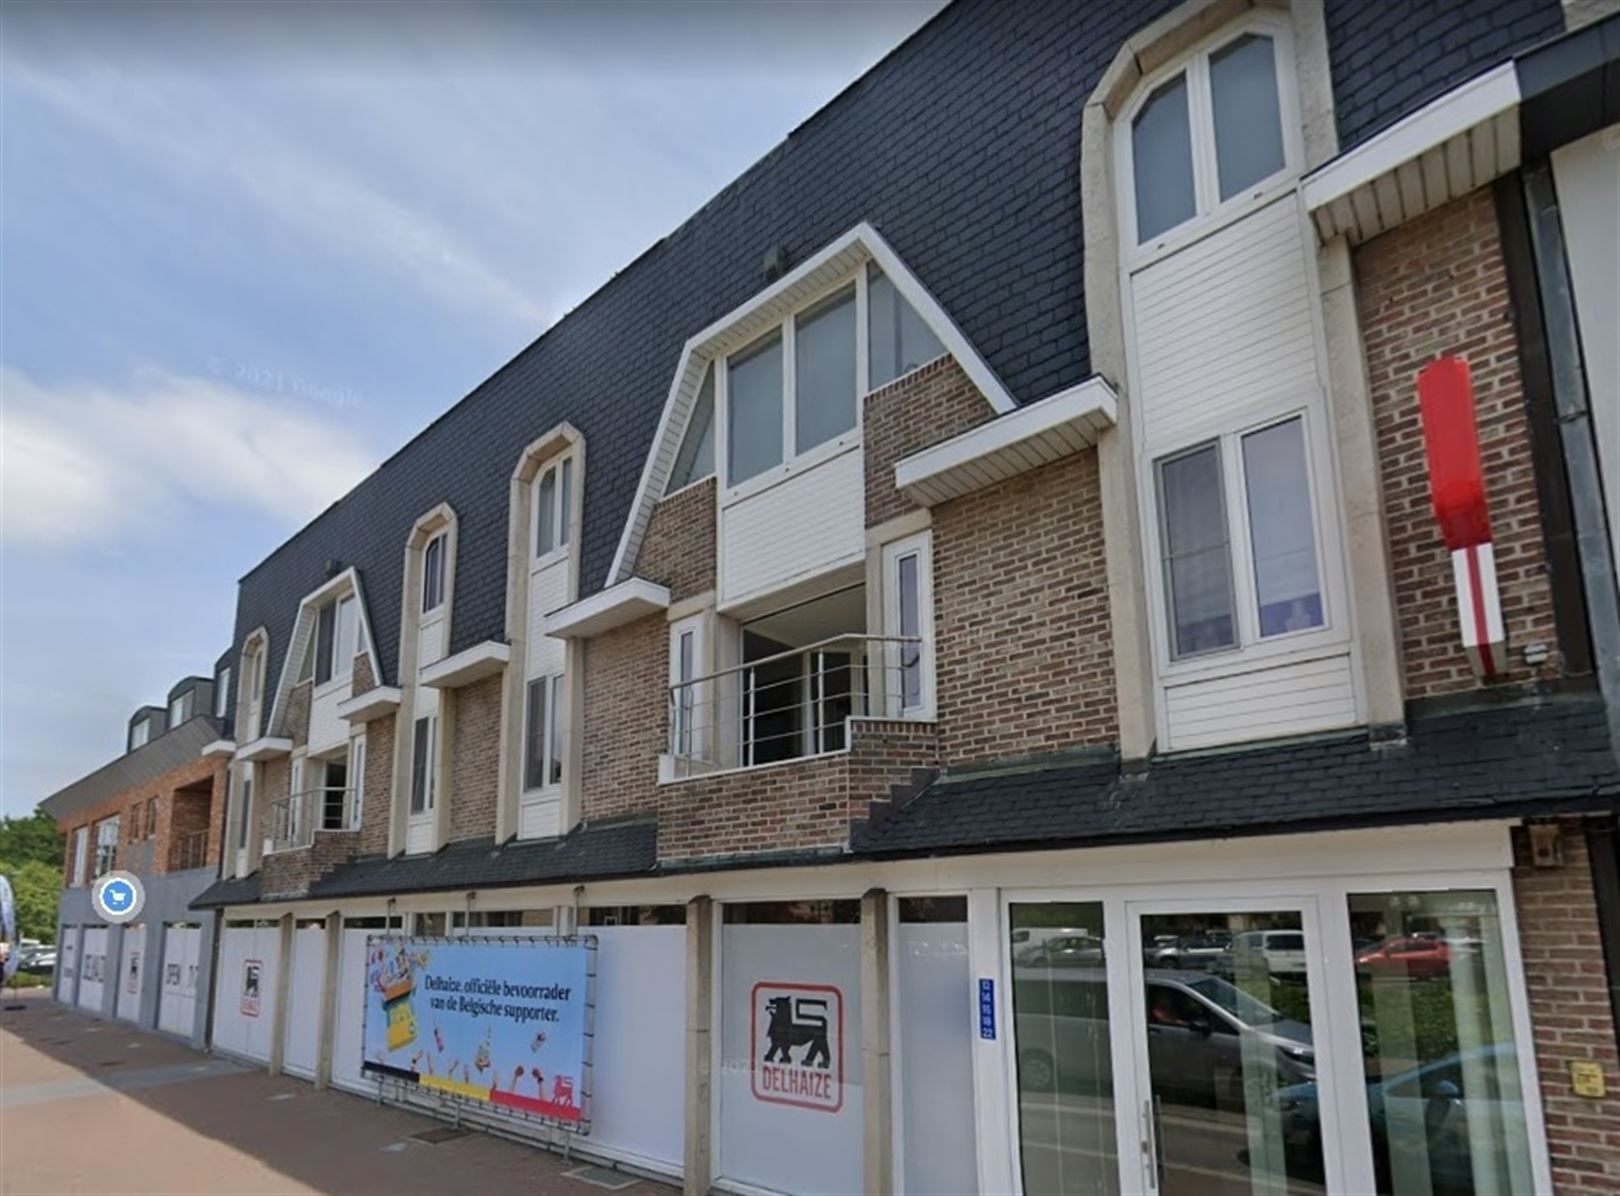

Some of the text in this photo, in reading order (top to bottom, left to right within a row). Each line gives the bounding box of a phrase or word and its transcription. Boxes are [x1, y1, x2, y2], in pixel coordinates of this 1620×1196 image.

[504, 981, 571, 1001] bevoorrader
[430, 995, 560, 1023] van de Belgische supporter.
[763, 1066, 832, 1100] DELHAIZE
